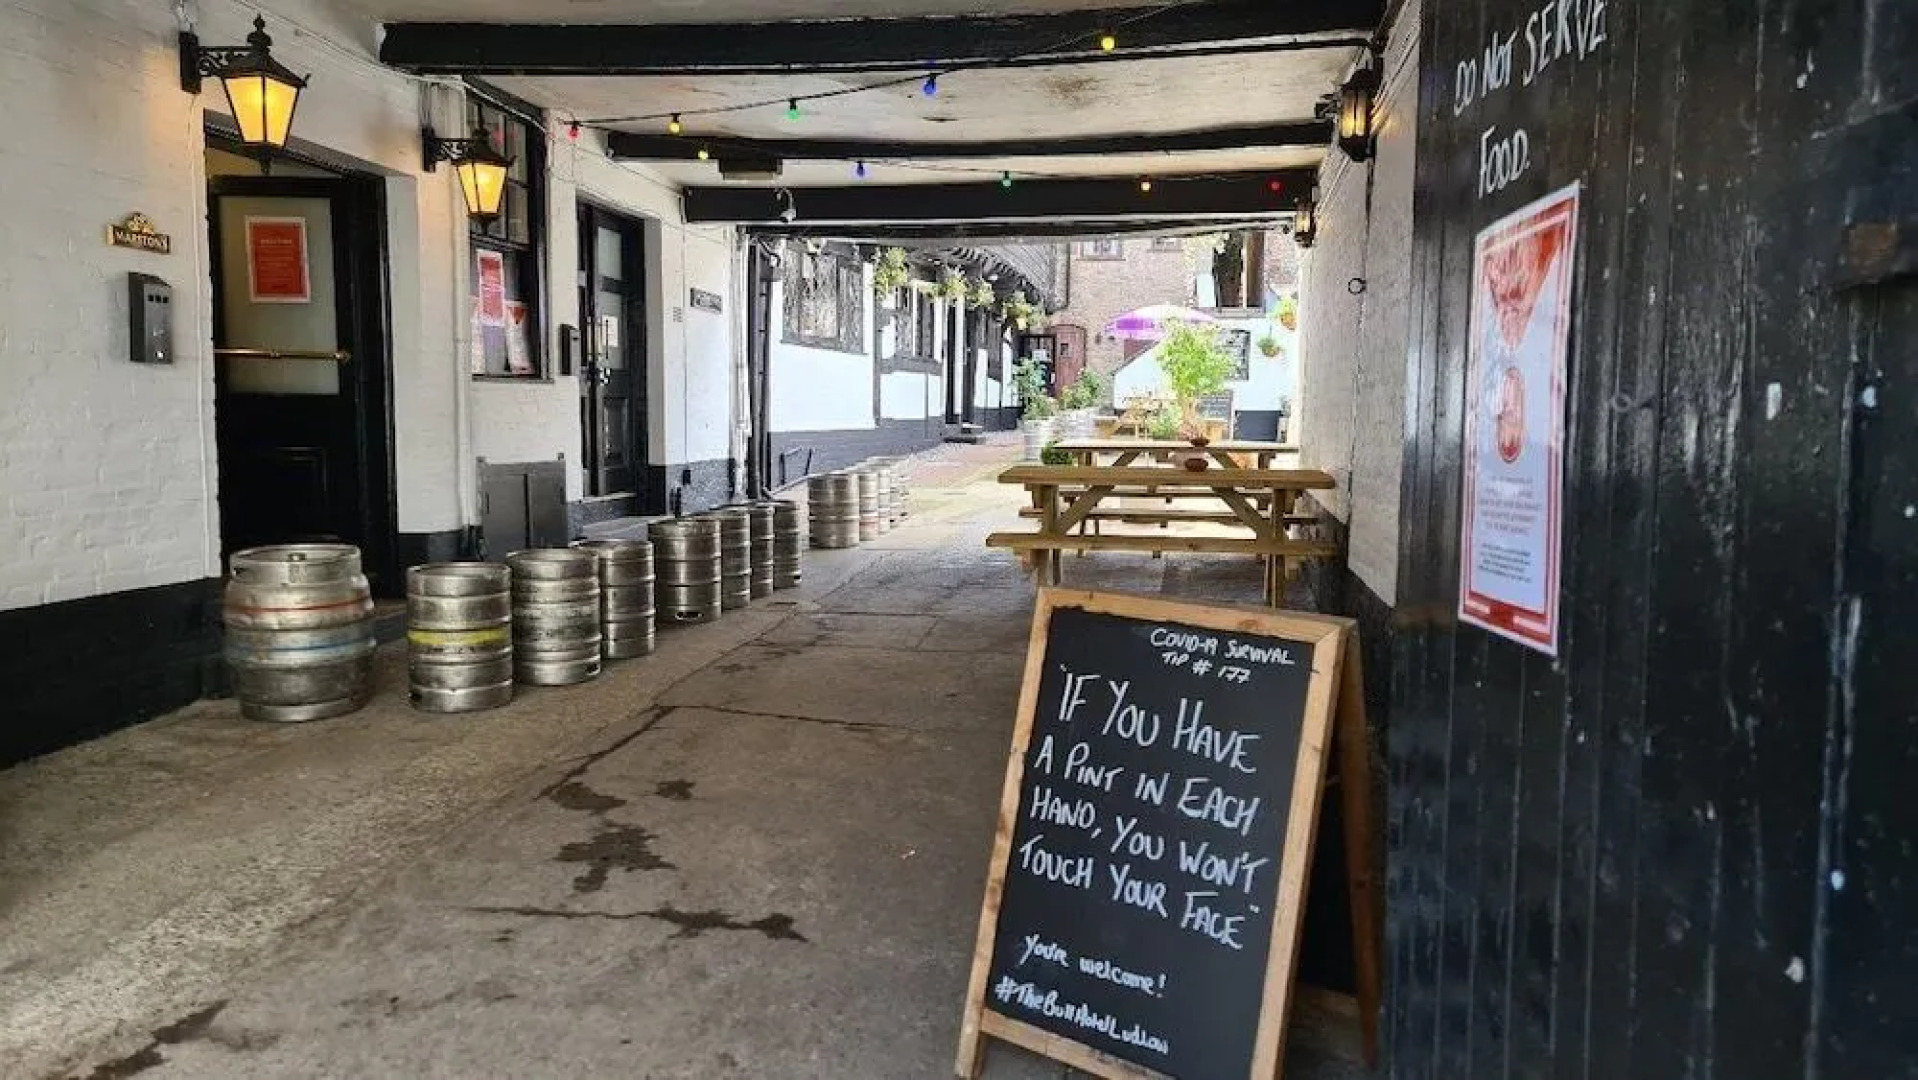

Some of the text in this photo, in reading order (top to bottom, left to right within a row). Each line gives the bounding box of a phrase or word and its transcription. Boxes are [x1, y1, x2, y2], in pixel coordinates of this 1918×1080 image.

[1453, 0, 1608, 118] DO NOT SERVE
[1150, 627, 1296, 666] COVID-19 SURVIVAL
[1162, 651, 1190, 667] TIP
[1102, 680, 1160, 747] YOU
[1172, 697, 1261, 774] HAVE
[1034, 734, 1261, 837] A PINT IN EACH
[1018, 833, 1095, 890] TOUCH
[1108, 863, 1169, 919] YOUR
[1109, 815, 1165, 861] YOU
[1178, 840, 1271, 895] WON'T
